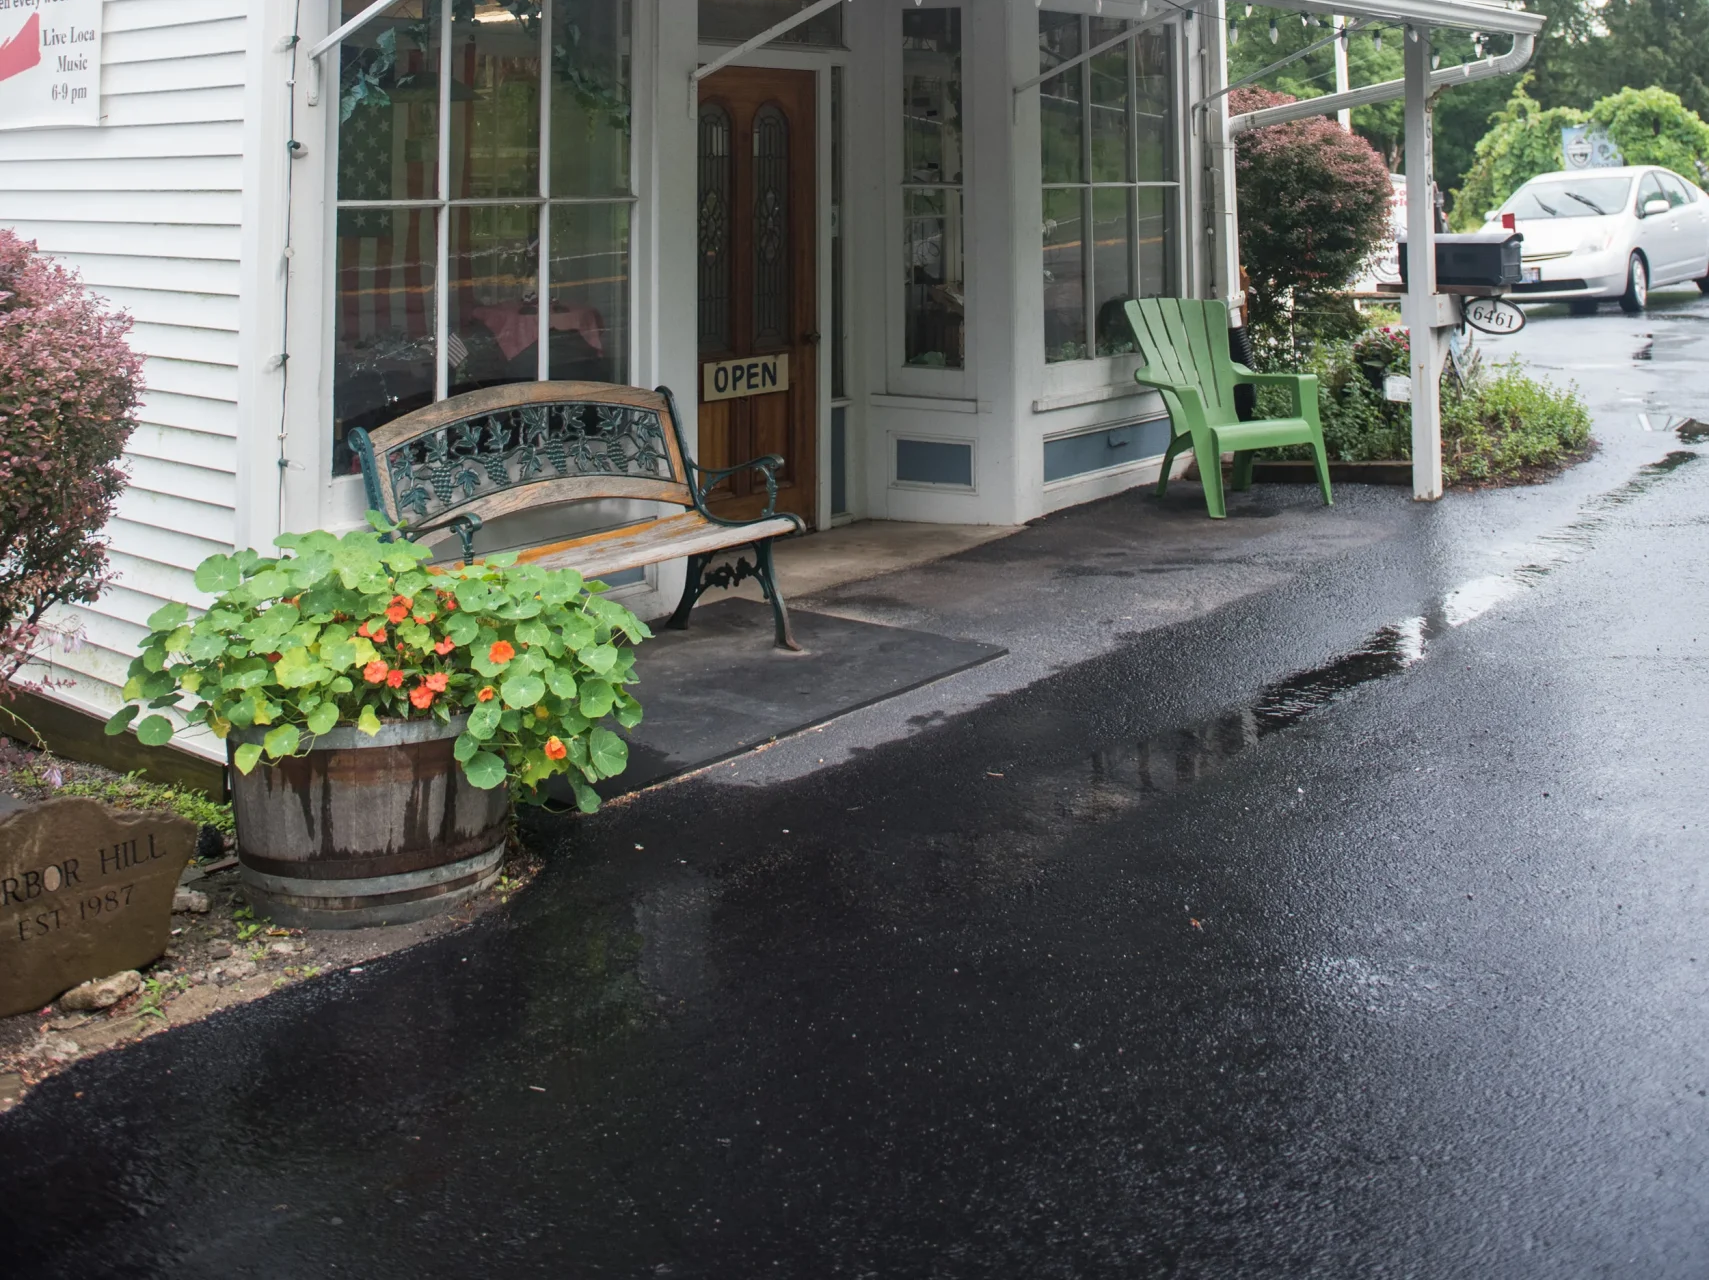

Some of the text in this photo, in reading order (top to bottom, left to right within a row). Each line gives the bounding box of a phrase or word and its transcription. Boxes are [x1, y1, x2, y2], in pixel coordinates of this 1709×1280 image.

[43, 28, 67, 47] Live
[56, 52, 88, 73] Music
[51, 82, 88, 105] 6-9 pm
[1473, 306, 1514, 329] 6461
[714, 361, 777, 393] OPEN
[98, 834, 167, 875] HILL
[79, 883, 135, 920] 1987
